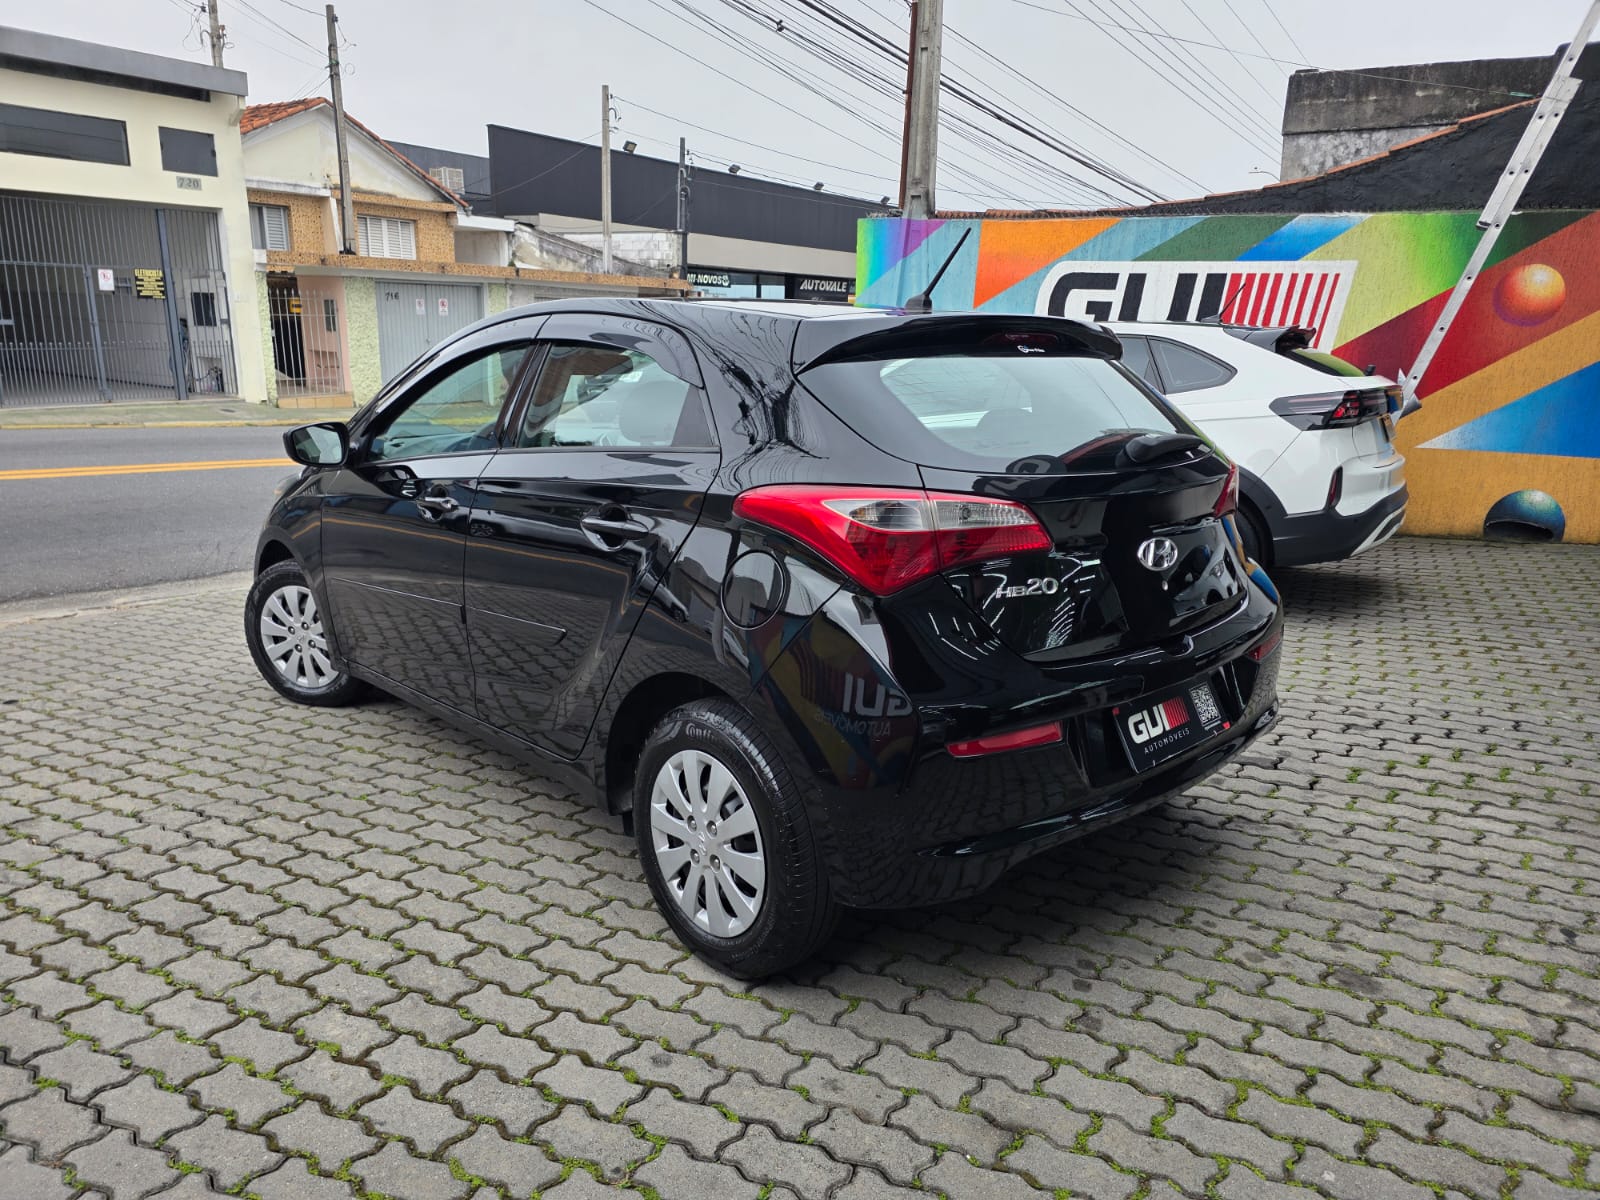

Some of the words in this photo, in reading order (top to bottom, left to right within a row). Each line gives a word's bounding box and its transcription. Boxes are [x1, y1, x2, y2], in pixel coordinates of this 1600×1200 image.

[800, 279, 848, 292] AUTOVALE
[996, 577, 1059, 598] HB20
[1128, 703, 1171, 744] GUI
